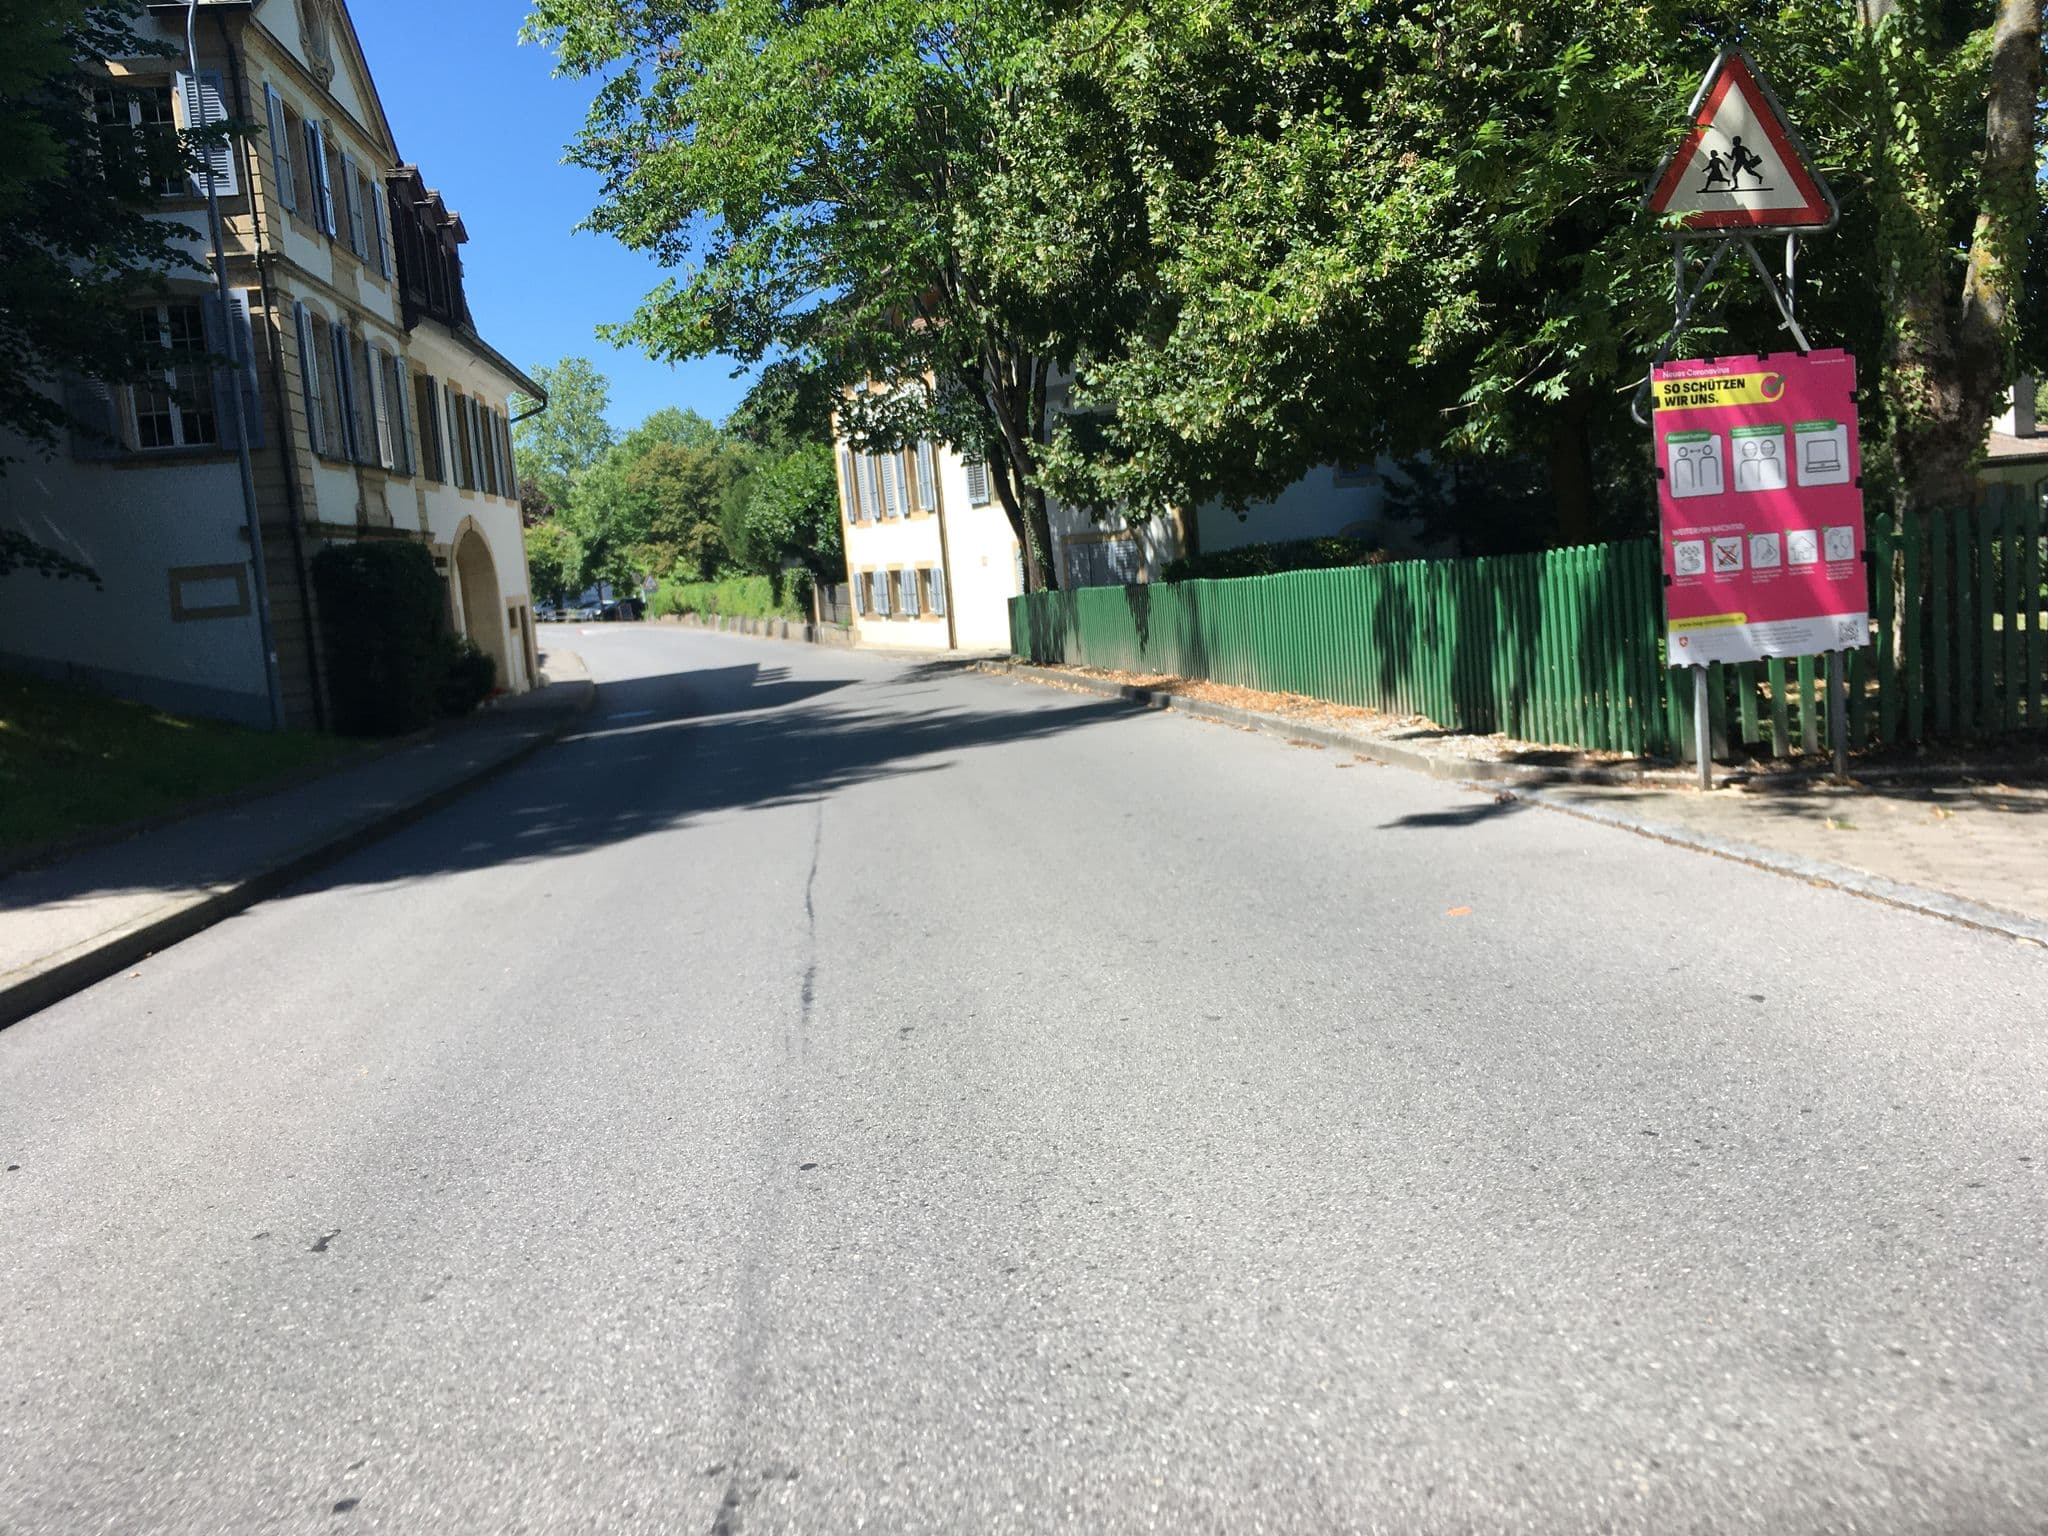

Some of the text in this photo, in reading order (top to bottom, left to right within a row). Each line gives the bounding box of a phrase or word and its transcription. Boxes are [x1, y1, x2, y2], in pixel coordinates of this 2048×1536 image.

[1662, 366, 1730, 378] Neues Coronavirus
[1664, 378, 1746, 394] SO SCHÜTZEN
[1664, 393, 1719, 407] WIR UNS.
